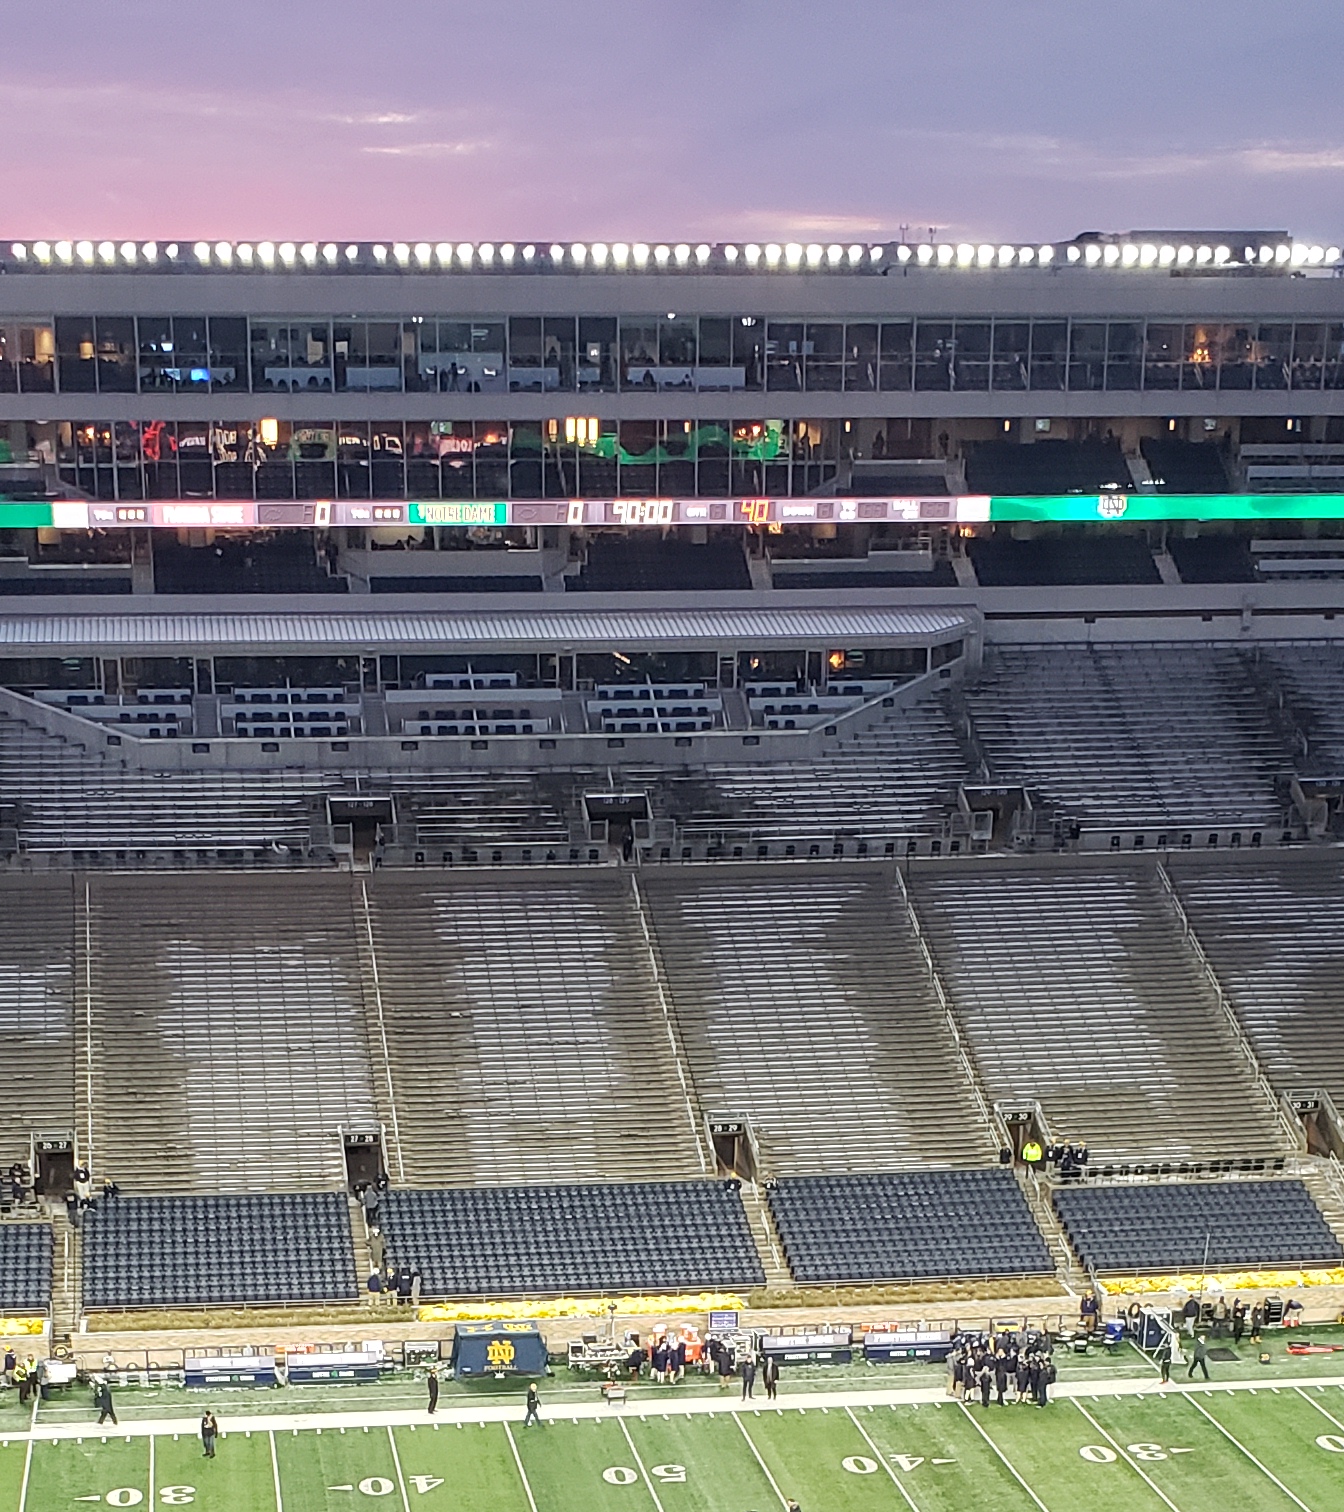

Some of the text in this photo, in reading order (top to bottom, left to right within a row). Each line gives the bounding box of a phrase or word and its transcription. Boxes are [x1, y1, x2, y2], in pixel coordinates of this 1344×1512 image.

[425, 504, 494, 522] NOTRE DAME
[741, 499, 769, 522] 40
[1307, 1101, 1315, 1109] 31
[1003, 1113, 1028, 1121] 29 30
[728, 1124, 738, 1132] 29
[42, 1141, 68, 1150] 26 27
[350, 1135, 374, 1143] 27 28
[487, 1340, 515, 1365] ND
[1079, 1442, 1170, 1463] 30
[841, 1452, 926, 1475] 40
[358, 1474, 444, 1496] 40
[602, 1464, 689, 1485] 50
[105, 1485, 197, 1507] 30
